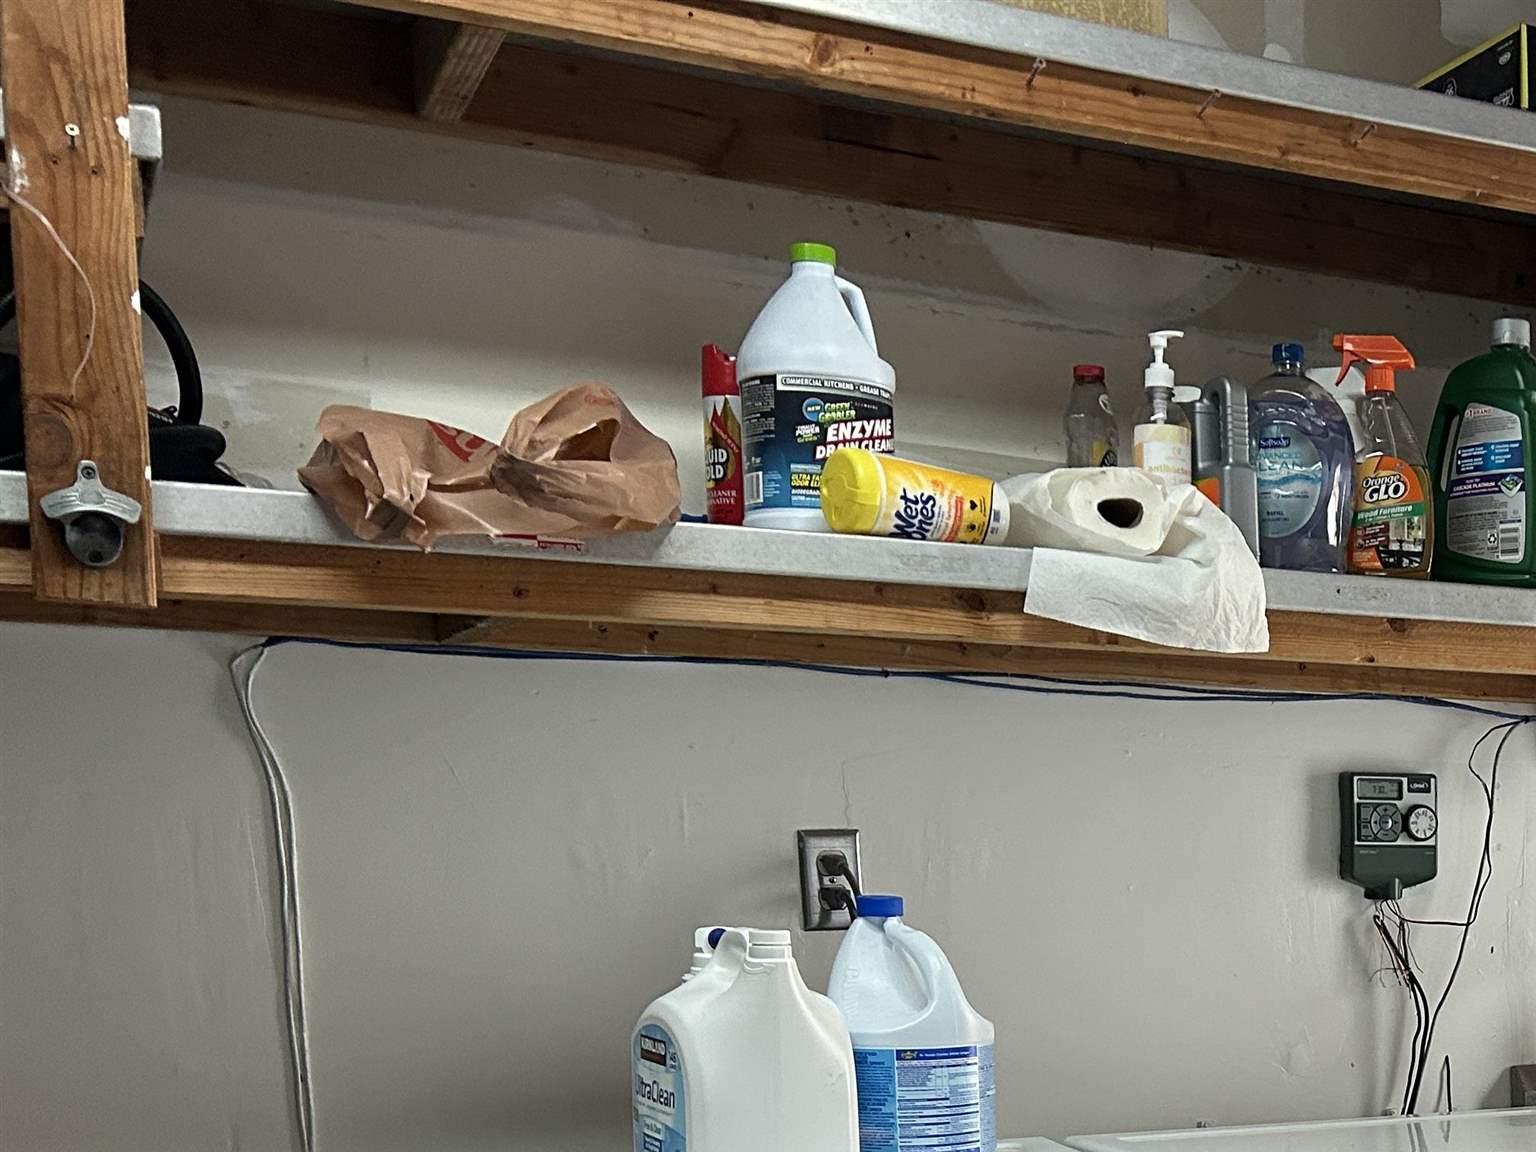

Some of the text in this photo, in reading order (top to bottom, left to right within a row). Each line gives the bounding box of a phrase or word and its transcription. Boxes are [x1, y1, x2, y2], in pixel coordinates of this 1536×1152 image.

[781, 376, 822, 387] COMMERCIAL
[823, 378, 854, 391] KITCHENS
[818, 409, 856, 422] GOBBLER
[826, 418, 893, 442] ENZYME
[1362, 473, 1401, 488] Orange
[1363, 483, 1406, 503] GLO
[1357, 509, 1378, 520] Wood
[1378, 505, 1413, 516] Furniture
[635, 1072, 676, 1109] UltraClean
